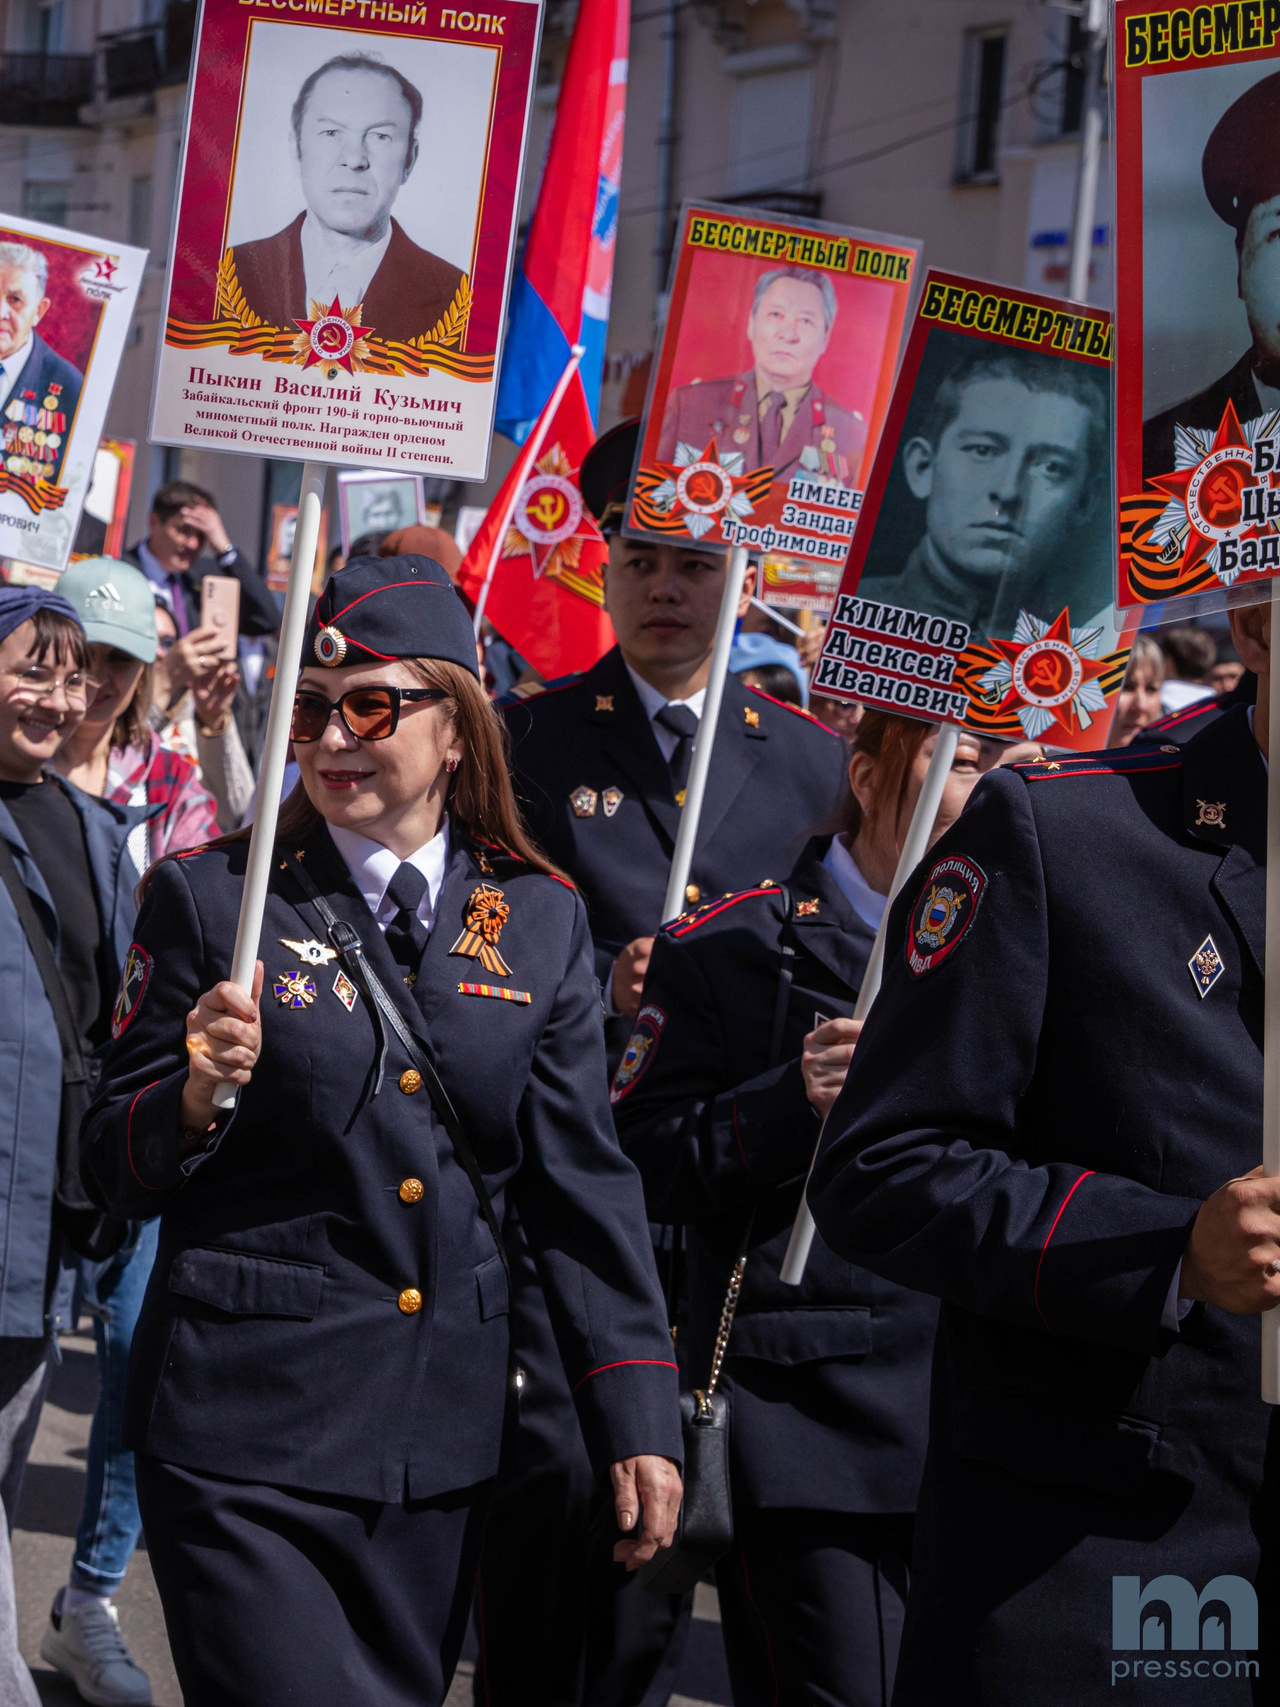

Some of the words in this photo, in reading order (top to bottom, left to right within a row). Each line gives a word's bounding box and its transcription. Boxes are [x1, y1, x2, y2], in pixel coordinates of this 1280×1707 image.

[238, 0, 427, 26] ССМЕРТНЫЙ
[440, 9, 506, 35] ПОЛК
[1126, 0, 1280, 67] БЕССМЕР
[689, 218, 850, 271] БЕССМЕРТНЫЙ
[854, 247, 913, 281] ПОЛК
[182, 389, 279, 410] Забайкальский
[282, 398, 322, 416] фронт
[326, 405, 359, 420] 190-й
[362, 411, 464, 432] горно-вьючный
[188, 366, 262, 391] Пыкин
[274, 376, 361, 402] Василий
[374, 388, 462, 414] Кузьмич
[183, 422, 238, 440] Великой
[241, 429, 338, 451] Отечественной
[341, 441, 382, 457] войны
[400, 450, 454, 466] степени.
[195, 409, 278, 428] минометный
[281, 419, 316, 433] полк.
[319, 422, 390, 442] Награжден
[393, 433, 445, 448] орденом
[1254, 440, 1280, 473] Б
[1189, 449, 1254, 534] ОТЕЧЕСТВЕННА
[835, 596, 969, 650] КЛИМОВ
[825, 629, 955, 683] Алексей
[1015, 642, 1079, 695] ОТЕЧЕСТВЕННАЯ
[817, 658, 969, 718] Иванович
[931, 860, 980, 894] ПОЛИЦИЯ
